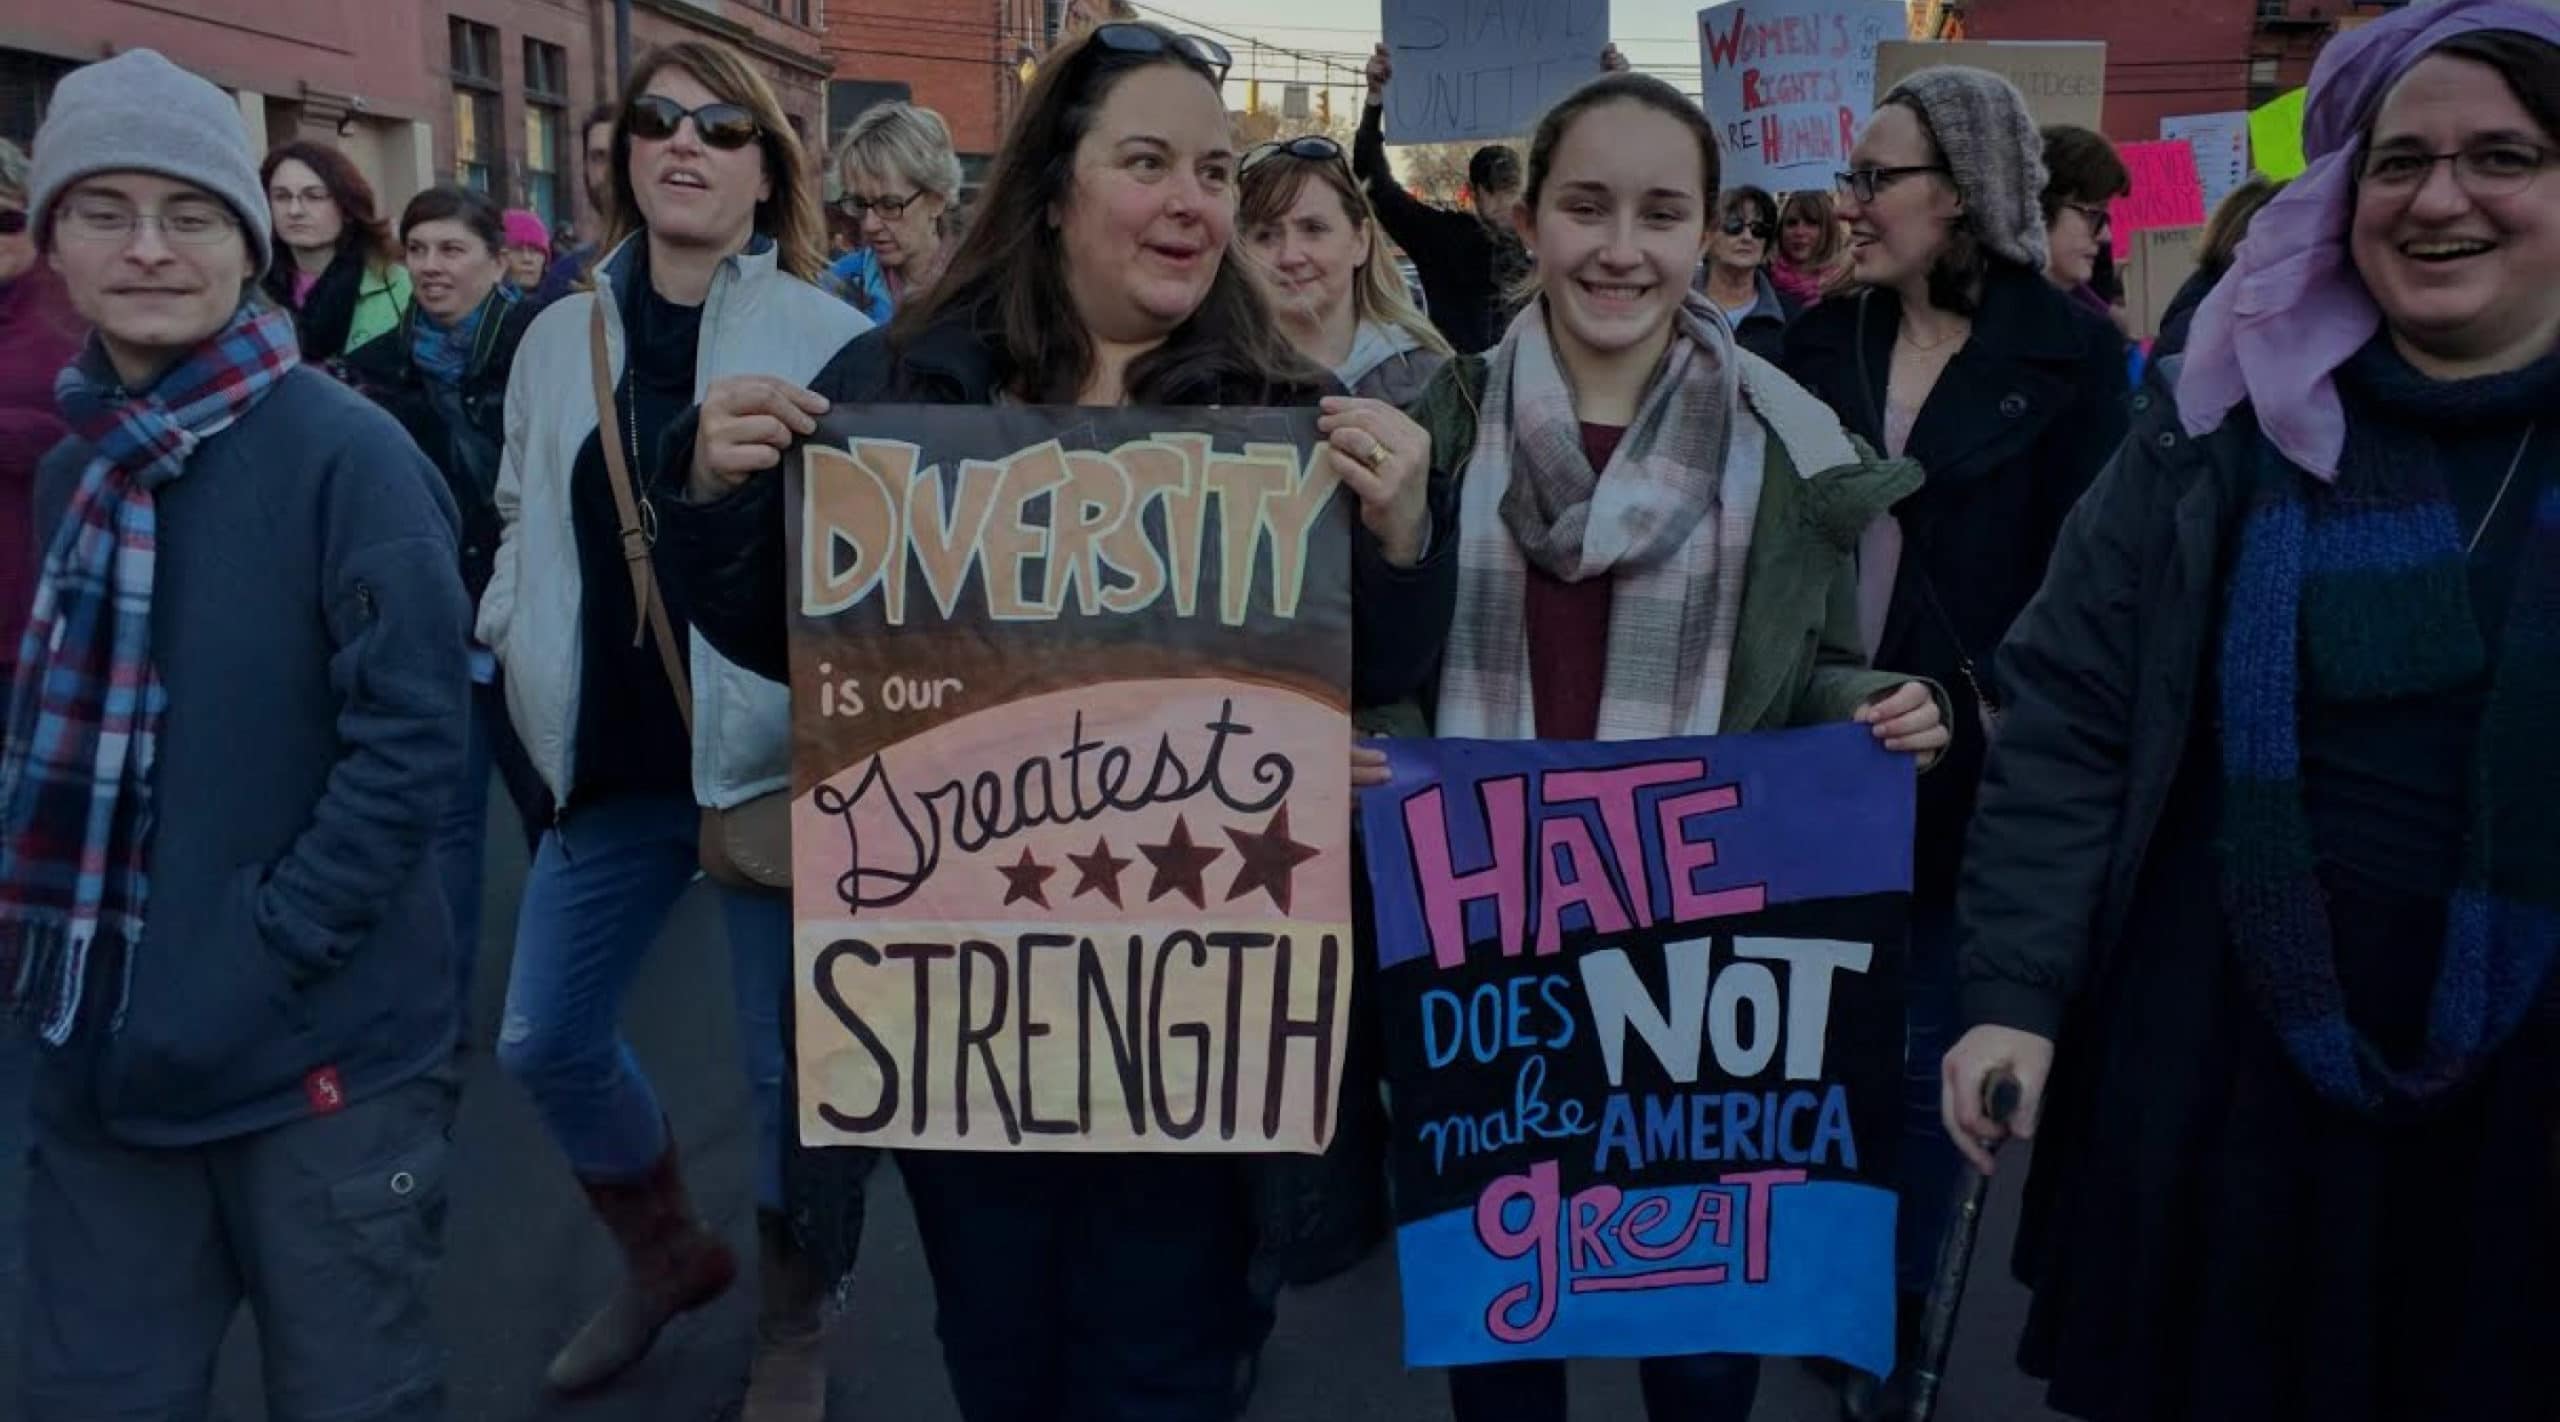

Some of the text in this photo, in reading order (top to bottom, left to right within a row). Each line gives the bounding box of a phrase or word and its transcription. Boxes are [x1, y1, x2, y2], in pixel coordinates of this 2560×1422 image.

[1742, 67, 1842, 112] RIGHTS
[1761, 113, 1833, 166] HUMAN
[802, 432, 1344, 624] DIVERSITY
[819, 662, 963, 716] is our
[813, 697, 1295, 914] Greatest
[1402, 757, 1767, 970] HATE
[812, 929, 1339, 1146] STRENGTH
[1420, 936, 1874, 1087] DOES NOT
[1419, 1054, 1859, 1175] make AMERICA
